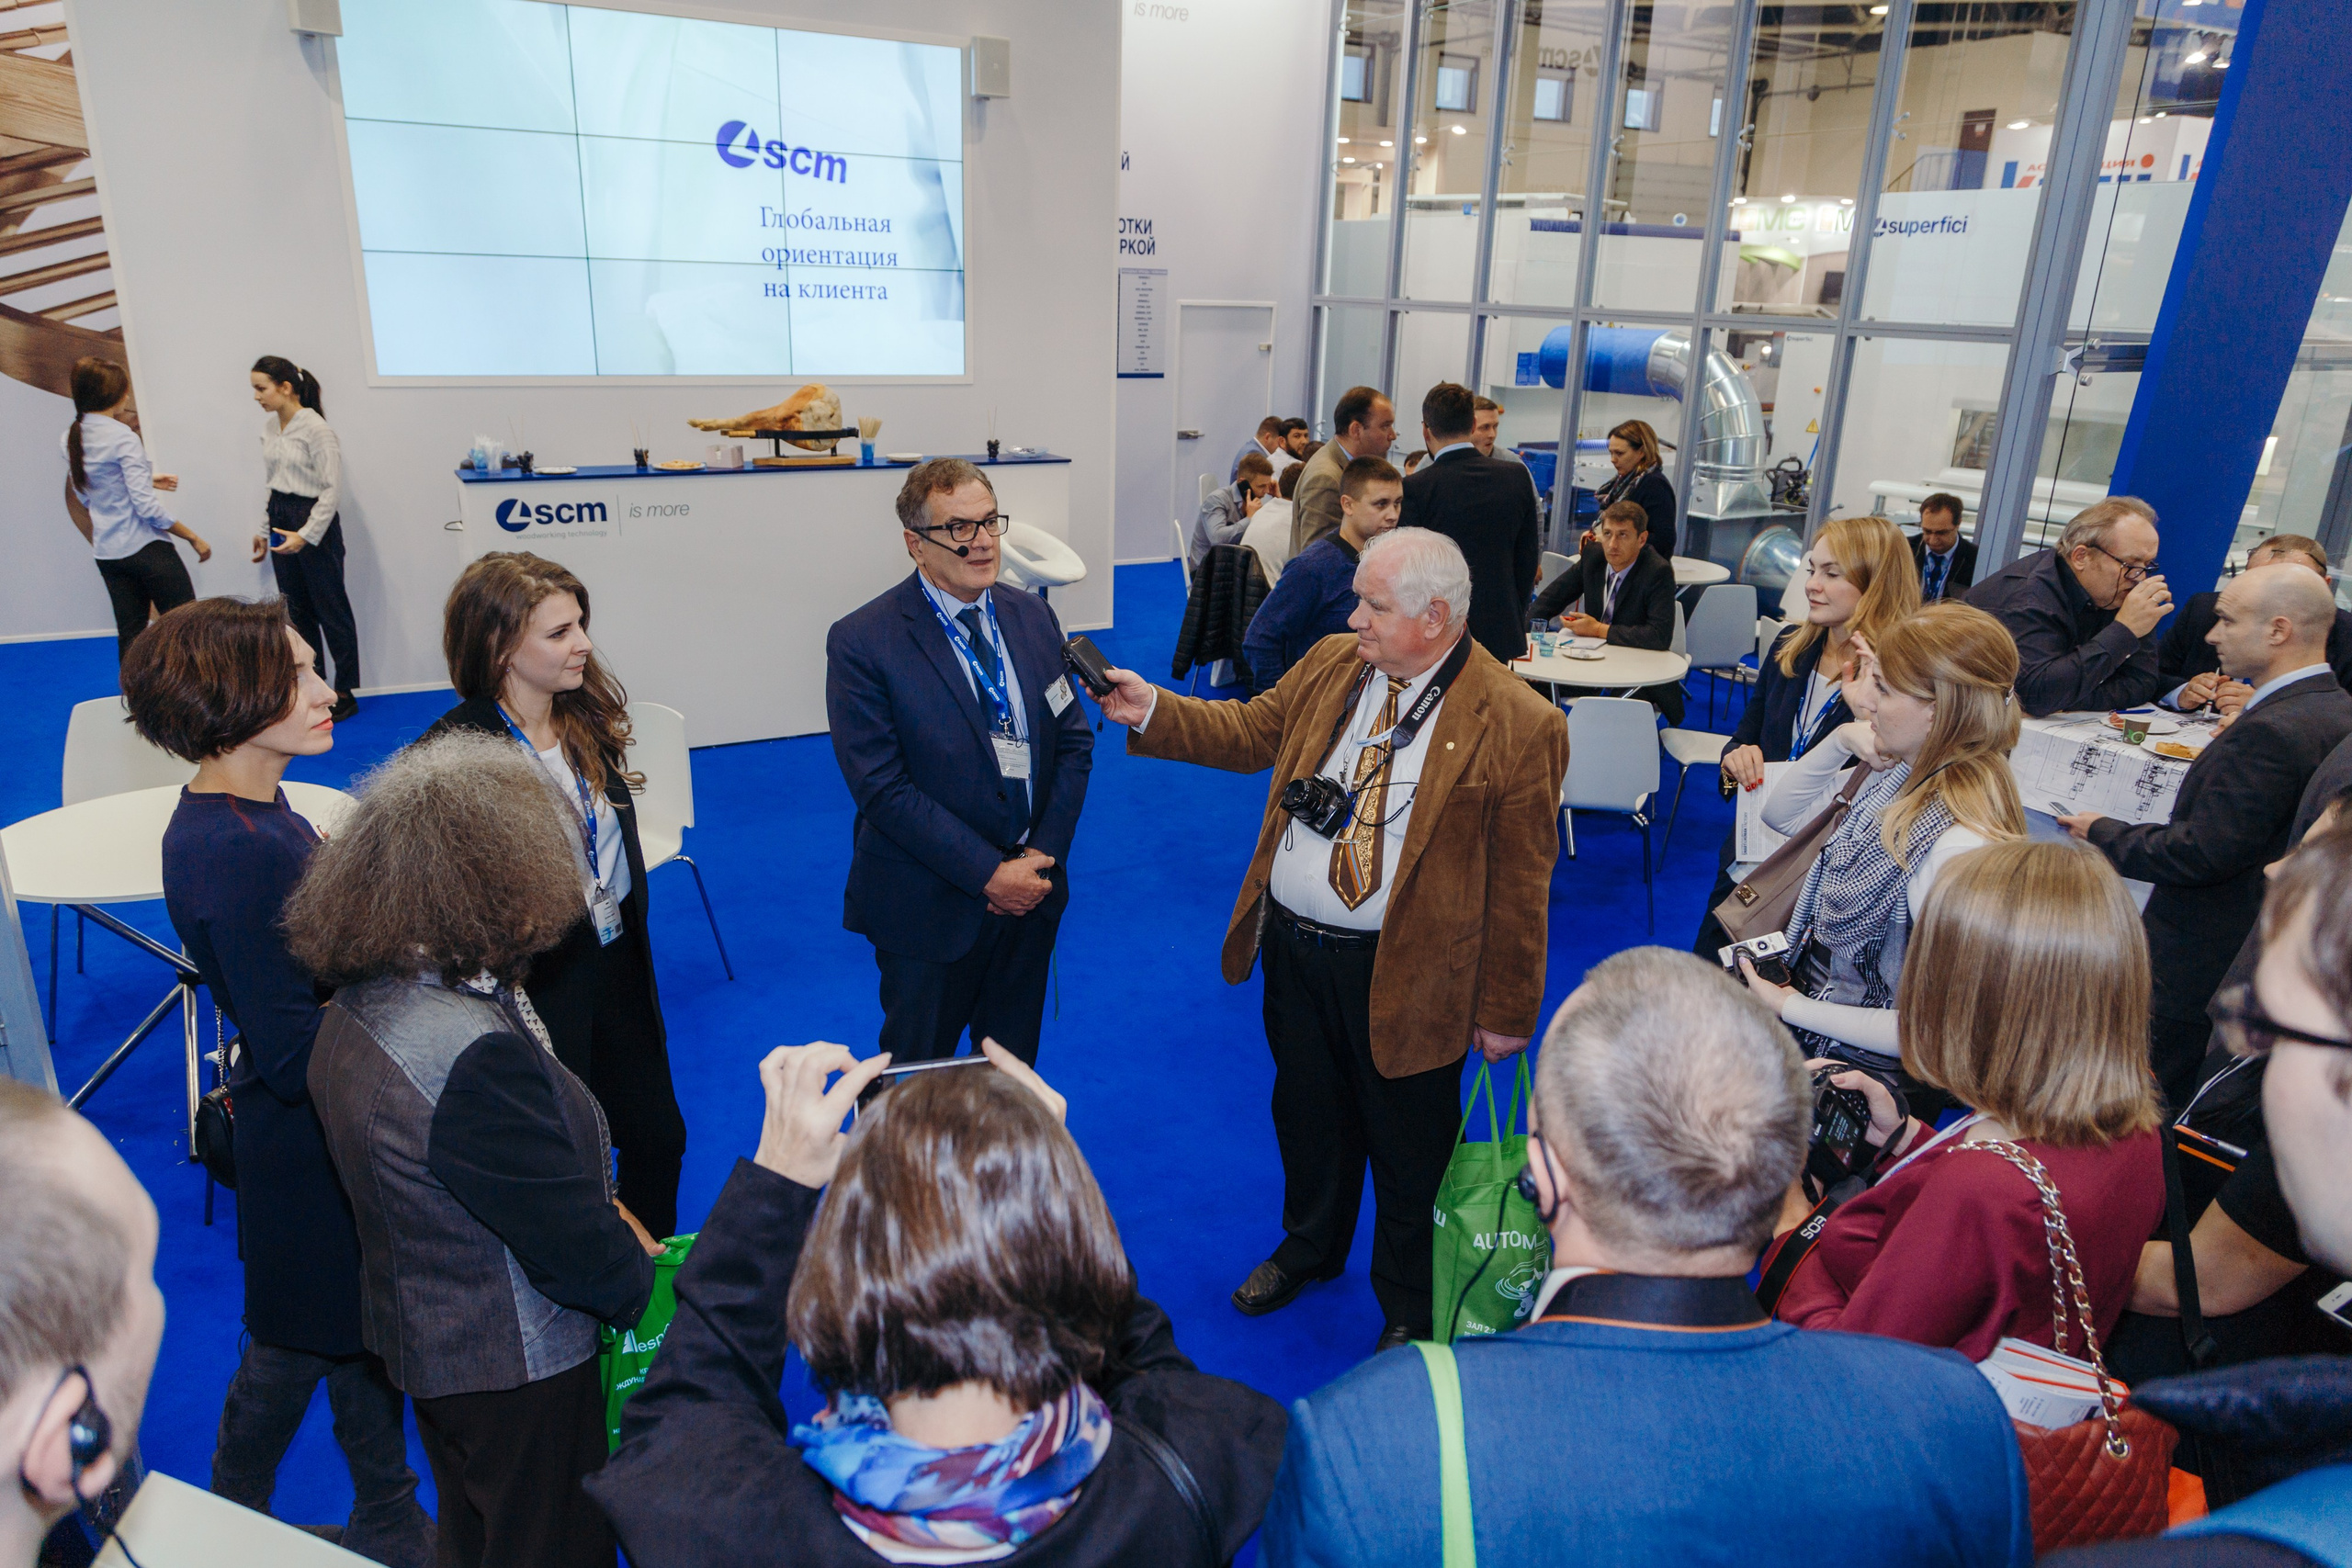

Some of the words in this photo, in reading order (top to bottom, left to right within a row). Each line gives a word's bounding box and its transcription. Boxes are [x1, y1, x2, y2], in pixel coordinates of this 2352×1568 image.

[1149, 4, 1189, 21] more
[763, 140, 847, 184] scm
[760, 206, 891, 232] Глобальная
[1888, 216, 1968, 237] superfici
[762, 247, 899, 270] ориентация
[763, 282, 790, 298] на
[798, 283, 888, 299] клиента
[535, 501, 607, 525] scm
[628, 502, 641, 518] is
[647, 503, 690, 517] more
[515, 531, 566, 540] woodworking
[568, 529, 607, 537] technology
[1411, 685, 1442, 721] Canon
[1801, 1214, 1827, 1240] EOS
[1465, 1320, 1483, 1332] ЗАЛ
